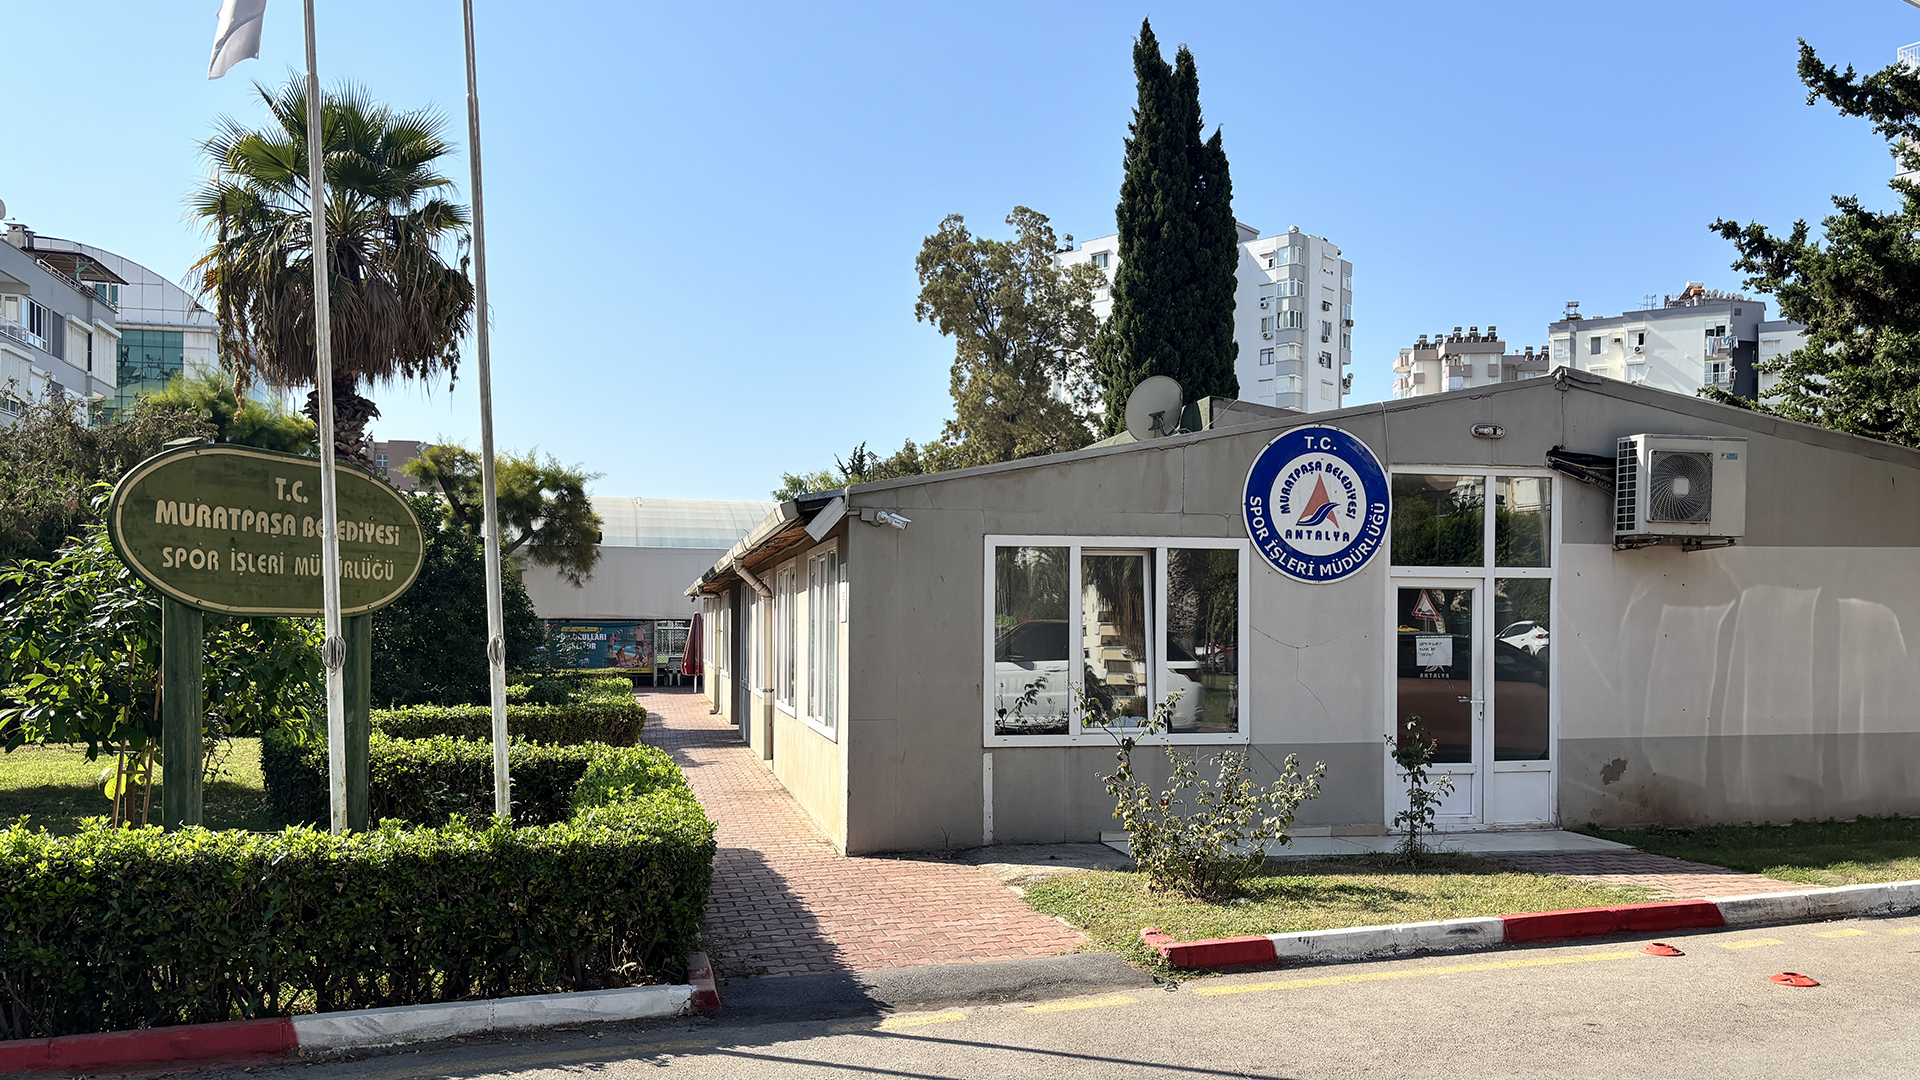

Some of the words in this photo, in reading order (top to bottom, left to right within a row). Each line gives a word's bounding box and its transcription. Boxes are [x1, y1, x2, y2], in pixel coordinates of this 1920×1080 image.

[1304, 436, 1337, 451] T.C.
[275, 477, 308, 504] T.C.
[1280, 461, 1322, 514] MURATPAŞA
[155, 499, 296, 538] MURATPAŞA
[302, 516, 400, 546] BEEDİYESİ
[1250, 496, 1270, 542] SPOR
[1264, 539, 1315, 577] İŞLERİ
[1319, 502, 1386, 577] MÜDÜRLÜĞÜ
[1285, 529, 1350, 542] ANTALYA
[162, 547, 219, 571] SPOR
[230, 548, 285, 576] İŞLERİ
[294, 554, 394, 581] MÜRLÜĞÜ
